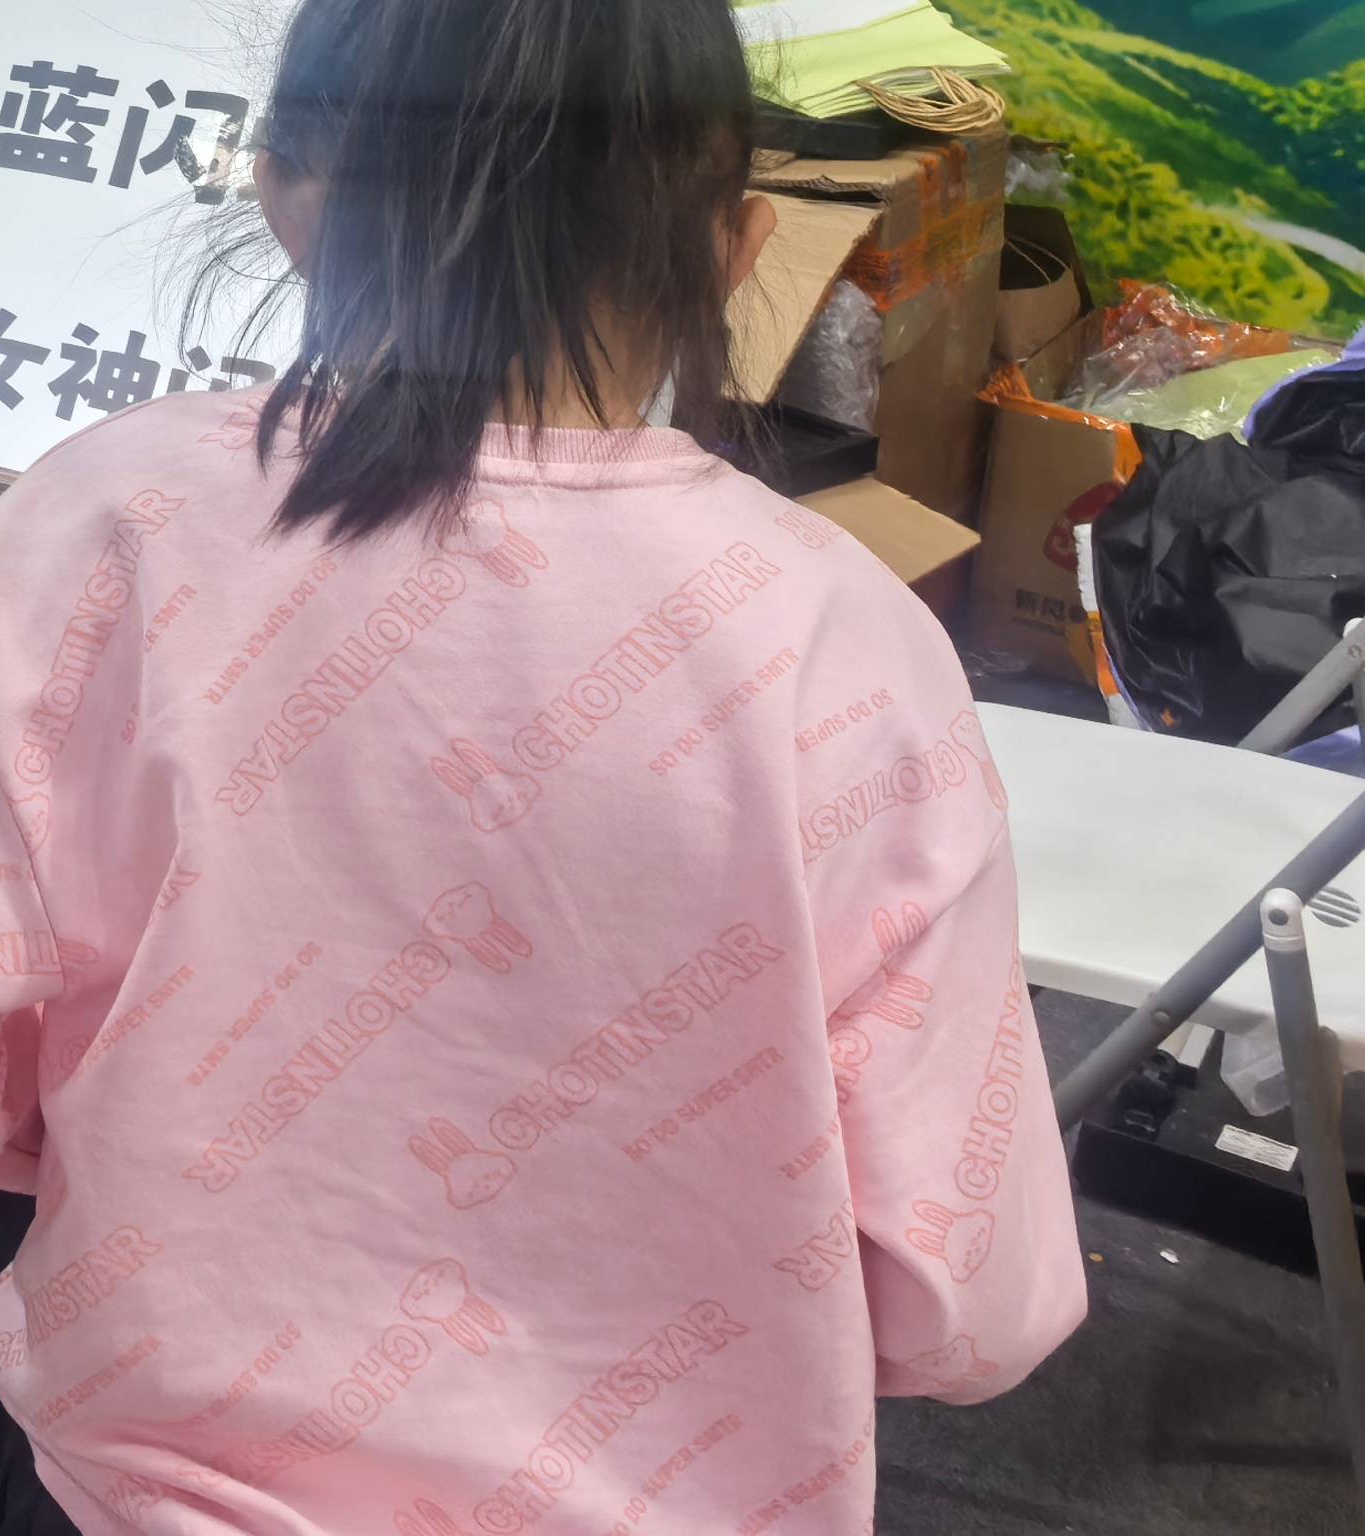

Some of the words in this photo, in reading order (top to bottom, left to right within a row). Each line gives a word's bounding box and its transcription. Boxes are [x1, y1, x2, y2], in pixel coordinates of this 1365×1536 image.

[215, 558, 466, 817] CHOTINSTAR
[512, 542, 783, 771] CHOTINSTAR
[181, 940, 452, 1194] CHOTINSTAR
[489, 921, 789, 1150] CHOTINSTAR
[472, 1299, 750, 1536] CHOTINSTAR
